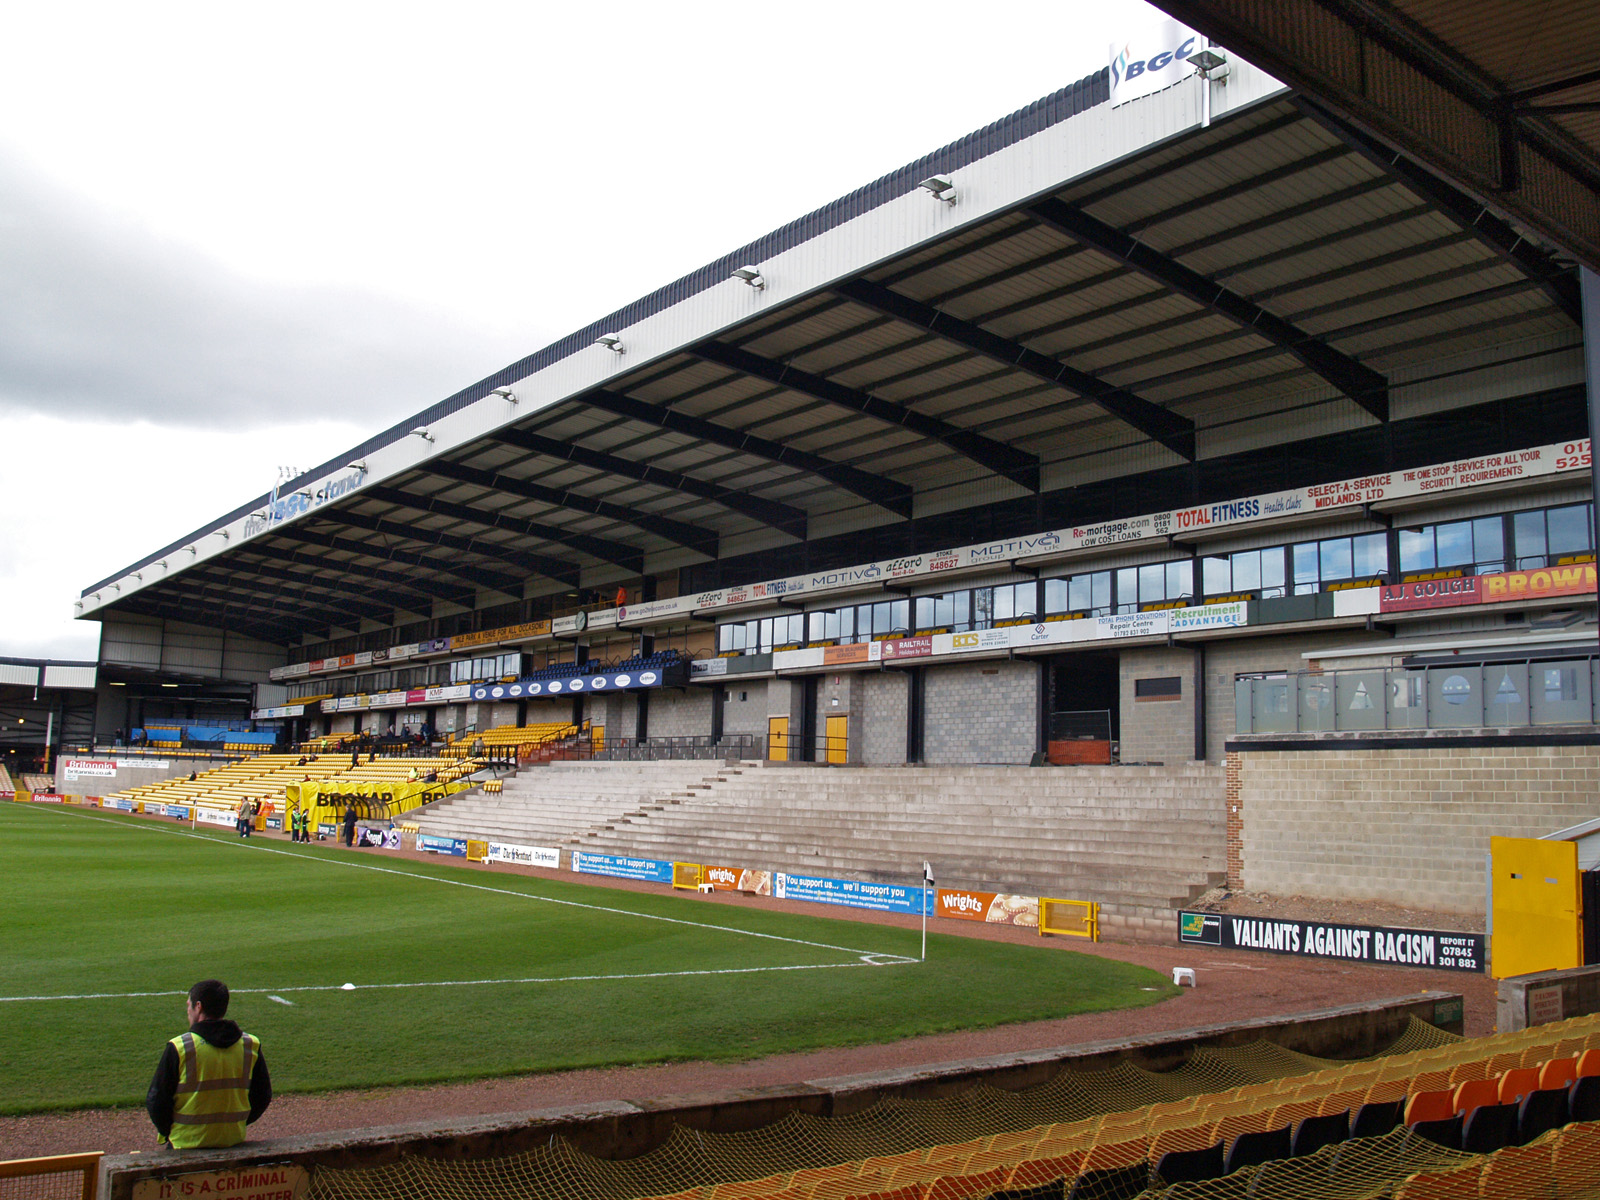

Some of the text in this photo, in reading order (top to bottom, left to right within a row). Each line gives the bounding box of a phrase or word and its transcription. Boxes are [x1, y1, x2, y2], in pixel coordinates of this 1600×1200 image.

[1125, 37, 1195, 82] BGC
[1403, 450, 1541, 482] THE ONE STOP SERVICE FOR ALL YOUR
[1420, 466, 1523, 491] SECURITY REQUIREMENTS
[1307, 475, 1392, 498] SELECT-A-SERVICE
[1315, 488, 1384, 508] MIDLANDS LTD
[1153, 513, 1171, 521] 0800
[1176, 495, 1302, 529] TOTAL FITNESS Health Clubs
[1072, 517, 1150, 539] Re-mortgage.com
[1154, 520, 1171, 528] 0181
[1156, 527, 1169, 535] 562
[1081, 530, 1142, 547] LOW COST LOANS
[929, 559, 959, 571] 848627
[753, 583, 767, 598] TOTAL
[767, 581, 787, 596] FITNESS
[1383, 586, 1409, 601] A.J.
[1413, 579, 1475, 599] GOUGH
[1136, 612, 1166, 620] SOLUTIONS
[1174, 604, 1241, 619] Recruitment
[1110, 622, 1131, 630] Repair
[1175, 615, 1237, 627] ADVANTAGE
[899, 639, 931, 649] RAILTRAIL
[1031, 633, 1049, 641] Carter
[429, 689, 444, 697] KMF
[34, 795, 62, 803] Britannia
[588, 855, 604, 864] support
[627, 860, 645, 869] support
[708, 868, 736, 883] Wrights
[786, 876, 798, 886] You
[799, 877, 823, 889] support
[843, 883, 859, 892] we'll
[861, 885, 890, 897] support
[891, 888, 905, 897] you
[942, 893, 982, 912] Wrights
[1232, 918, 1435, 965] VALIANTS AGAINST RACISM
[1440, 936, 1475, 947] REPORT IT
[1442, 946, 1473, 958] 07845
[1439, 957, 1477, 969] 301 882
[160, 1171, 288, 1199] IT IS A CRIMINAL
